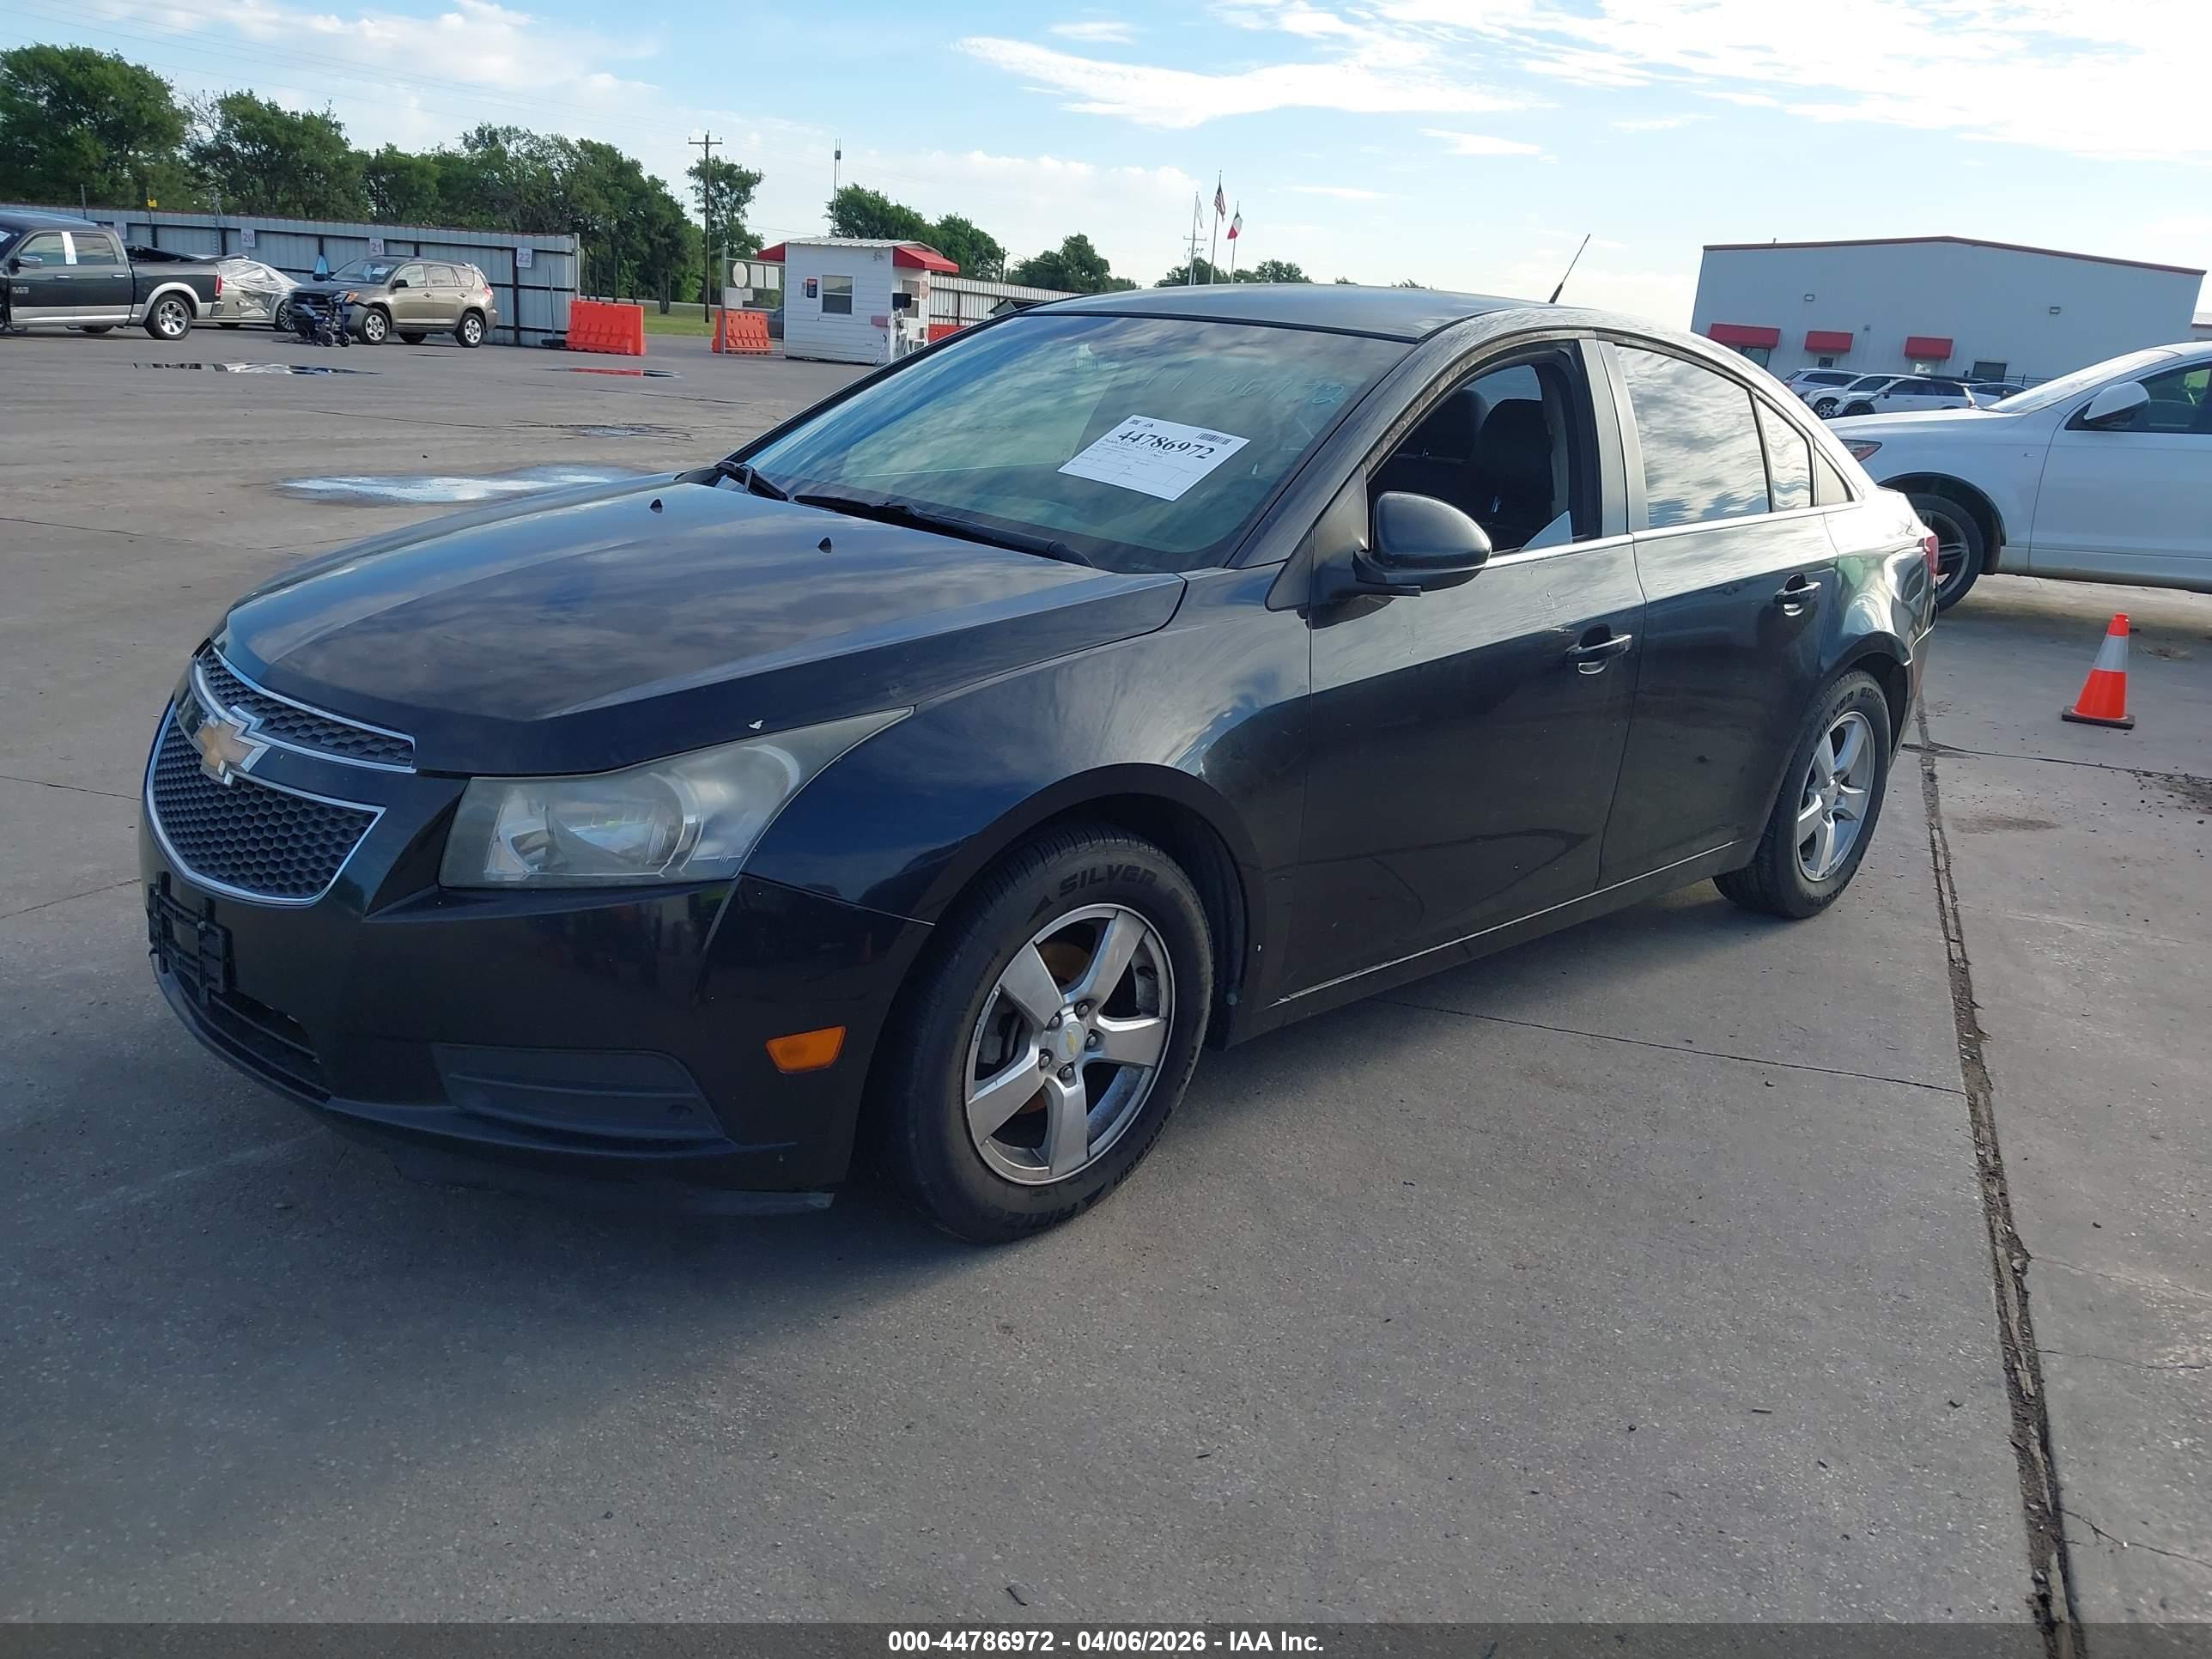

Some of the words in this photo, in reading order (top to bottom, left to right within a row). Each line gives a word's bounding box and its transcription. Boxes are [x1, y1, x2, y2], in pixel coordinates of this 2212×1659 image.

[243, 233, 254, 242] 20
[371, 242, 382, 252] 21
[519, 252, 530, 262] 22
[1118, 430, 1215, 459] 44786972
[1059, 864, 1158, 898] SILVER
